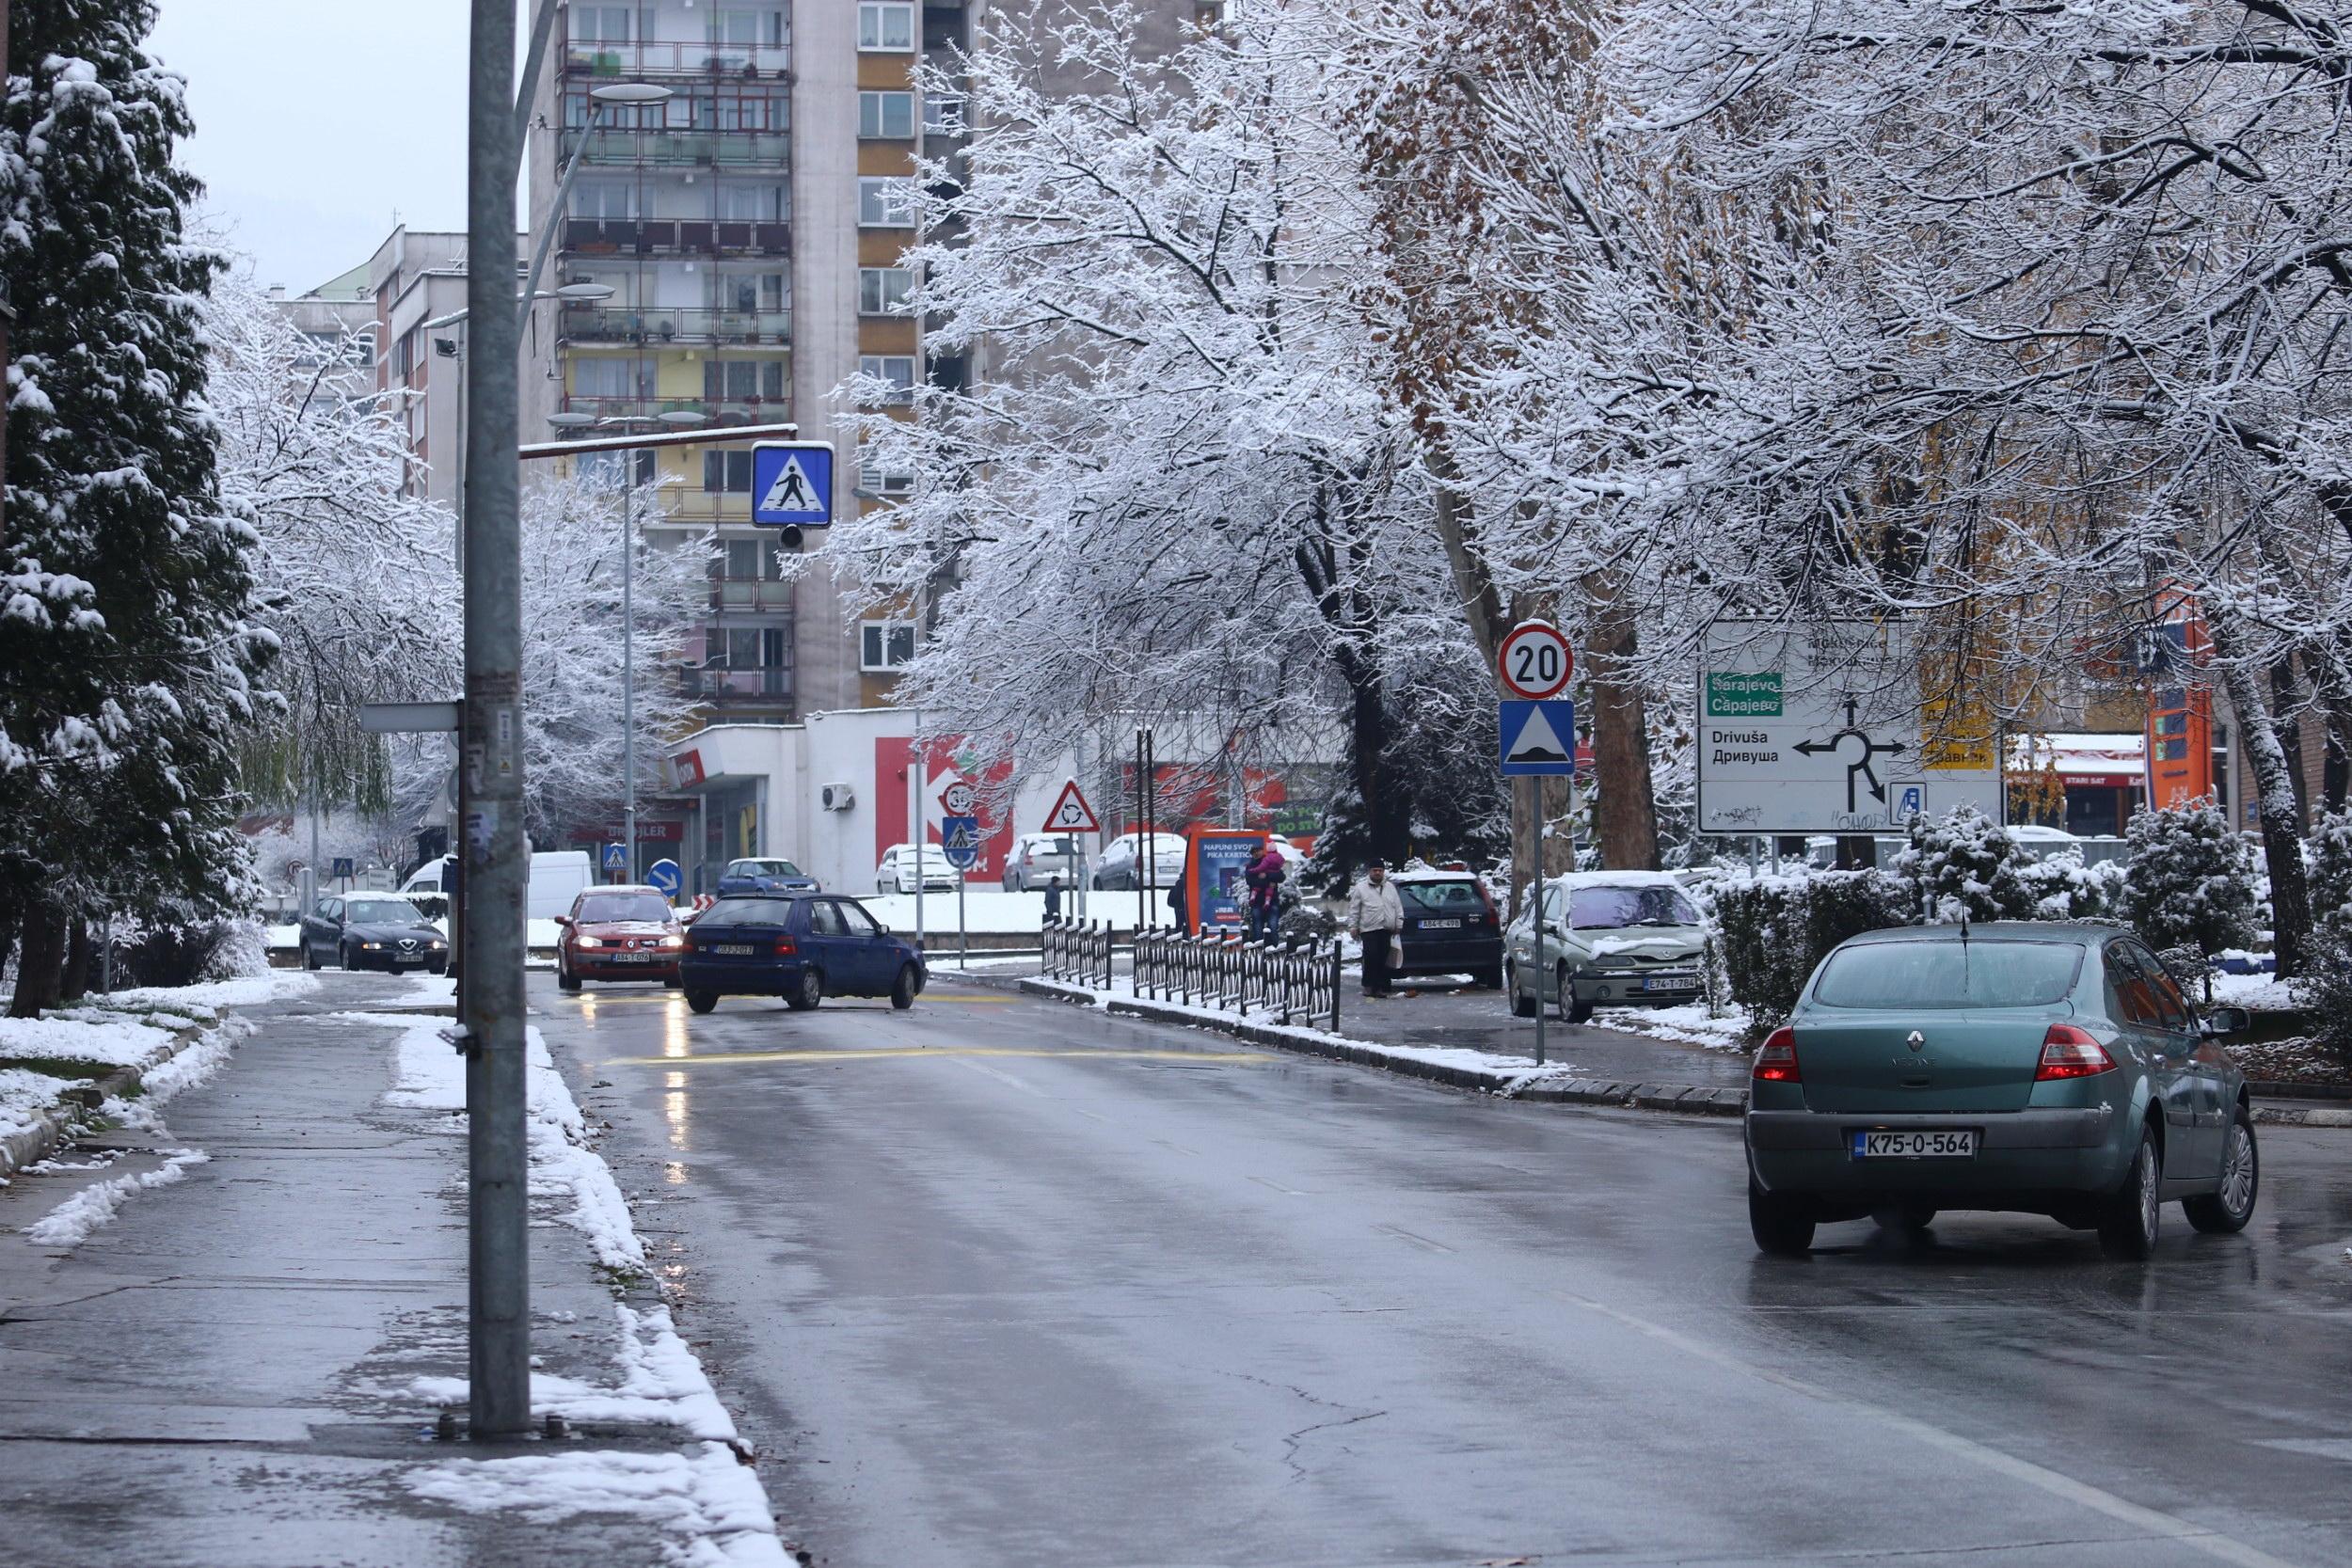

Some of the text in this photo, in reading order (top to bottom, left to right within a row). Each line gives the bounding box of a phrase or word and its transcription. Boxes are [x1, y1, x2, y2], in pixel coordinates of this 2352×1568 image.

[1516, 645, 1557, 682] 20
[1712, 677, 1777, 694] Sarajevo
[1712, 699, 1779, 714] Сарајево
[1712, 730, 1769, 743] Drivuša
[1712, 750, 1779, 765] Дривуша
[608, 826, 666, 838] BRJLER
[1233, 844, 1252, 852] SVOJ
